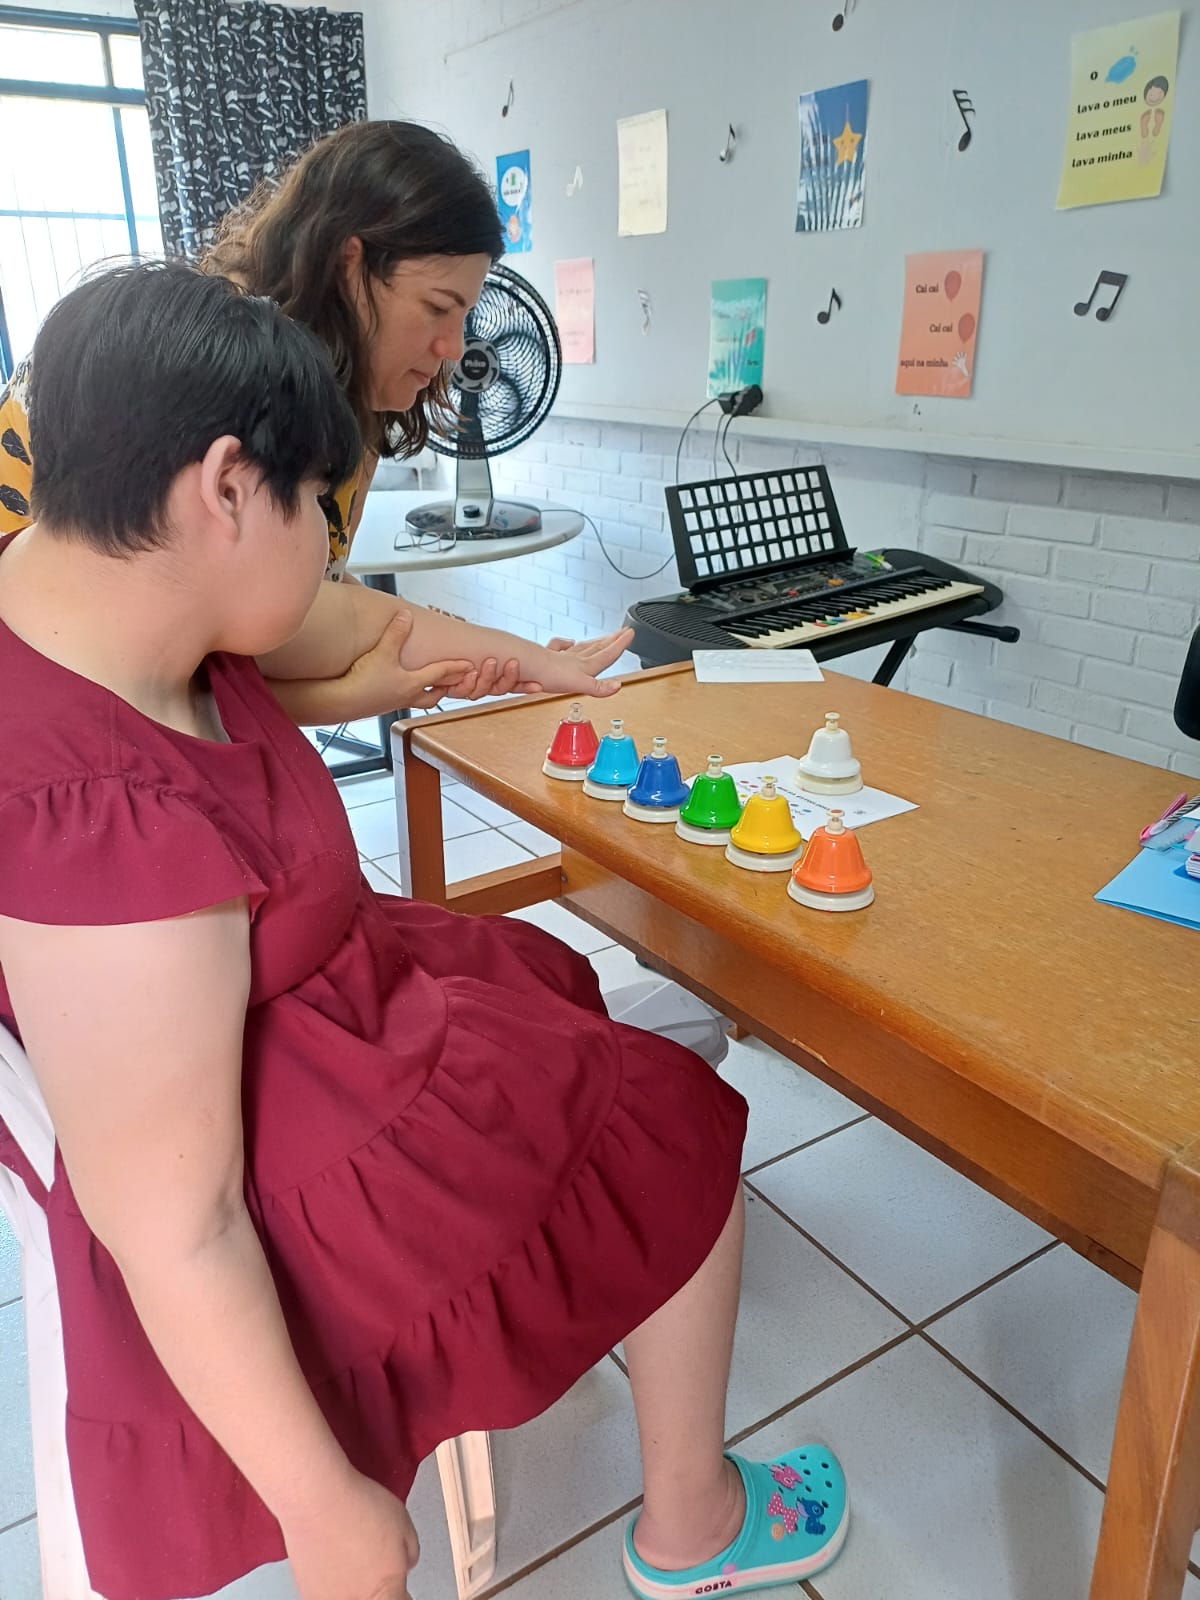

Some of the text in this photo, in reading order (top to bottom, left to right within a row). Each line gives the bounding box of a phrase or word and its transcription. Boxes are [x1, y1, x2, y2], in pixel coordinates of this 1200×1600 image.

[1077, 95, 1137, 114] lava o meu
[1076, 124, 1132, 141] lava meus
[1072, 150, 1133, 168] lava minha
[915, 283, 939, 294] Cai cai
[929, 323, 953, 333] Cai cai
[926, 357, 948, 367] minha
